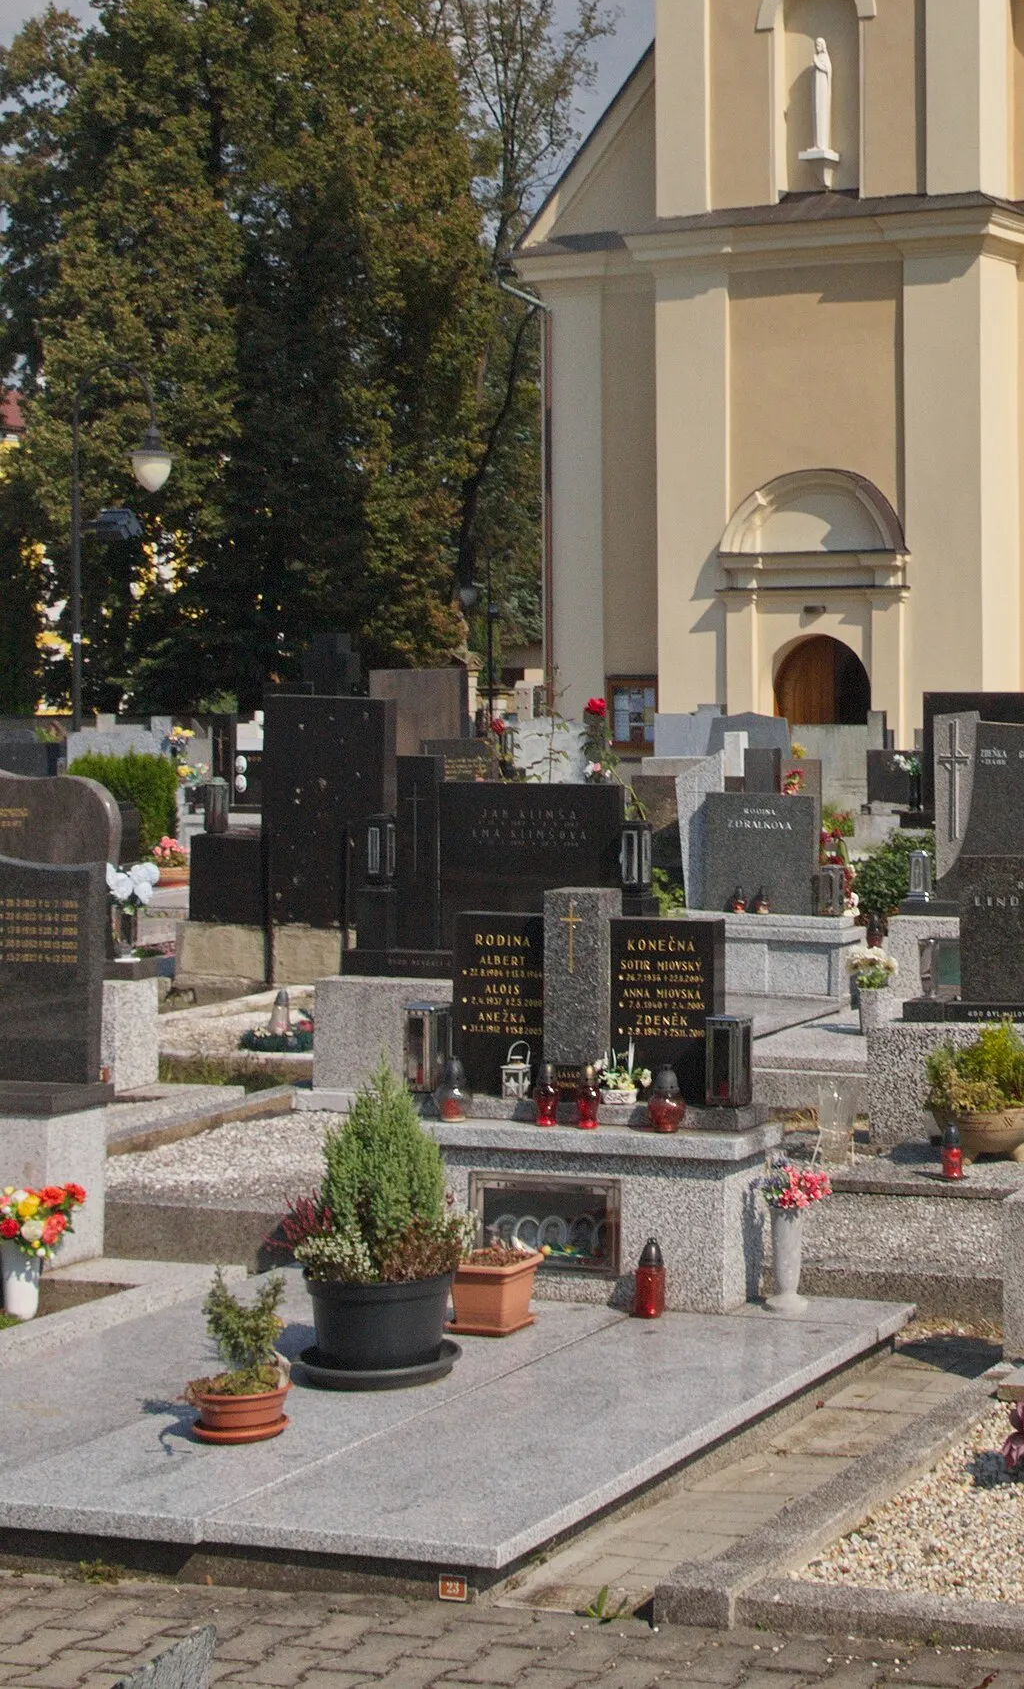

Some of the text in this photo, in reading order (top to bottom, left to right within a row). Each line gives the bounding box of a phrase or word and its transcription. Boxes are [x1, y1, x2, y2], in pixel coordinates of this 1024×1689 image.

[474, 933, 531, 948] RODINA
[626, 935, 696, 952] KONEČNÁ
[480, 955, 526, 966] ALBERT
[620, 960, 651, 971] SOTIR
[484, 984, 520, 995] ALOIS
[622, 988, 650, 999] ANNA
[478, 1009, 526, 1023] ANEŽKA
[636, 1012, 688, 1026] ZDENĚK
[446, 1581, 460, 1595] 23
